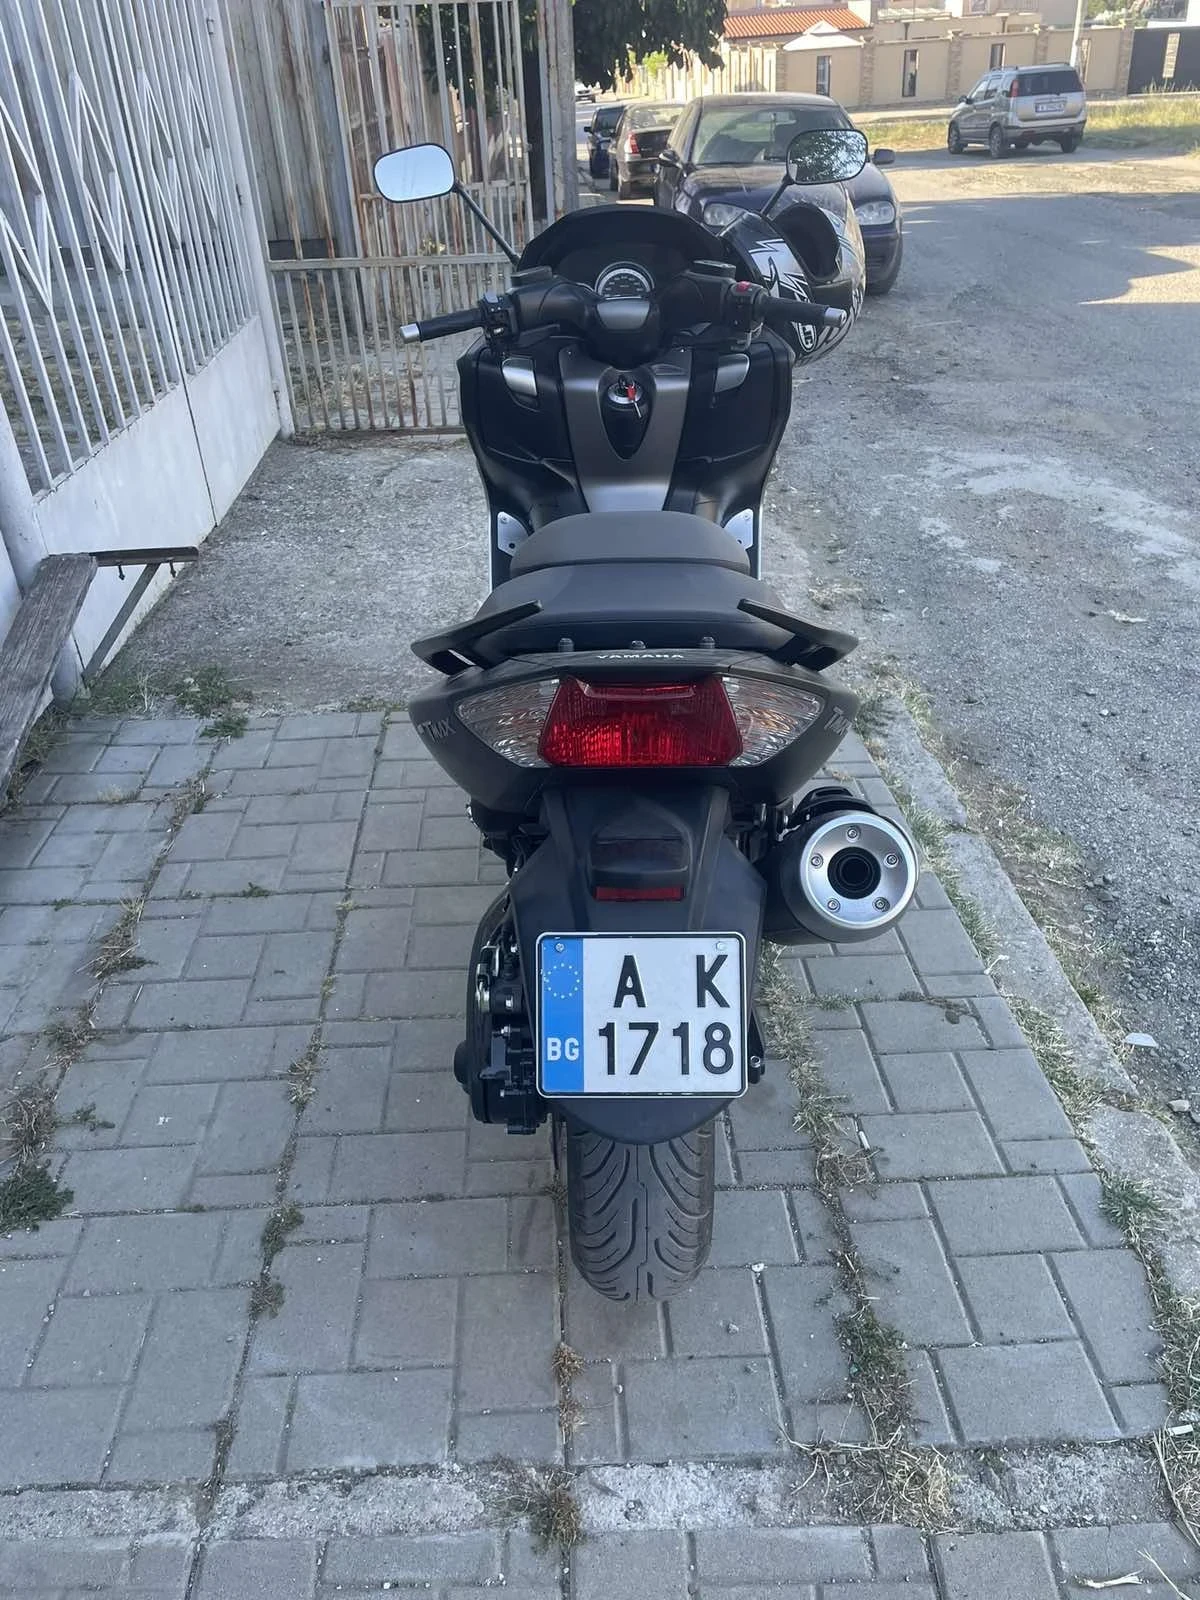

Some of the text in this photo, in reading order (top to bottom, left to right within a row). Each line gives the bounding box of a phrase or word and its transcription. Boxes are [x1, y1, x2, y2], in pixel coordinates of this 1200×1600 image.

[613, 954, 731, 1008] A K
[546, 1037, 580, 1061] BG
[598, 1021, 735, 1075] 1718
